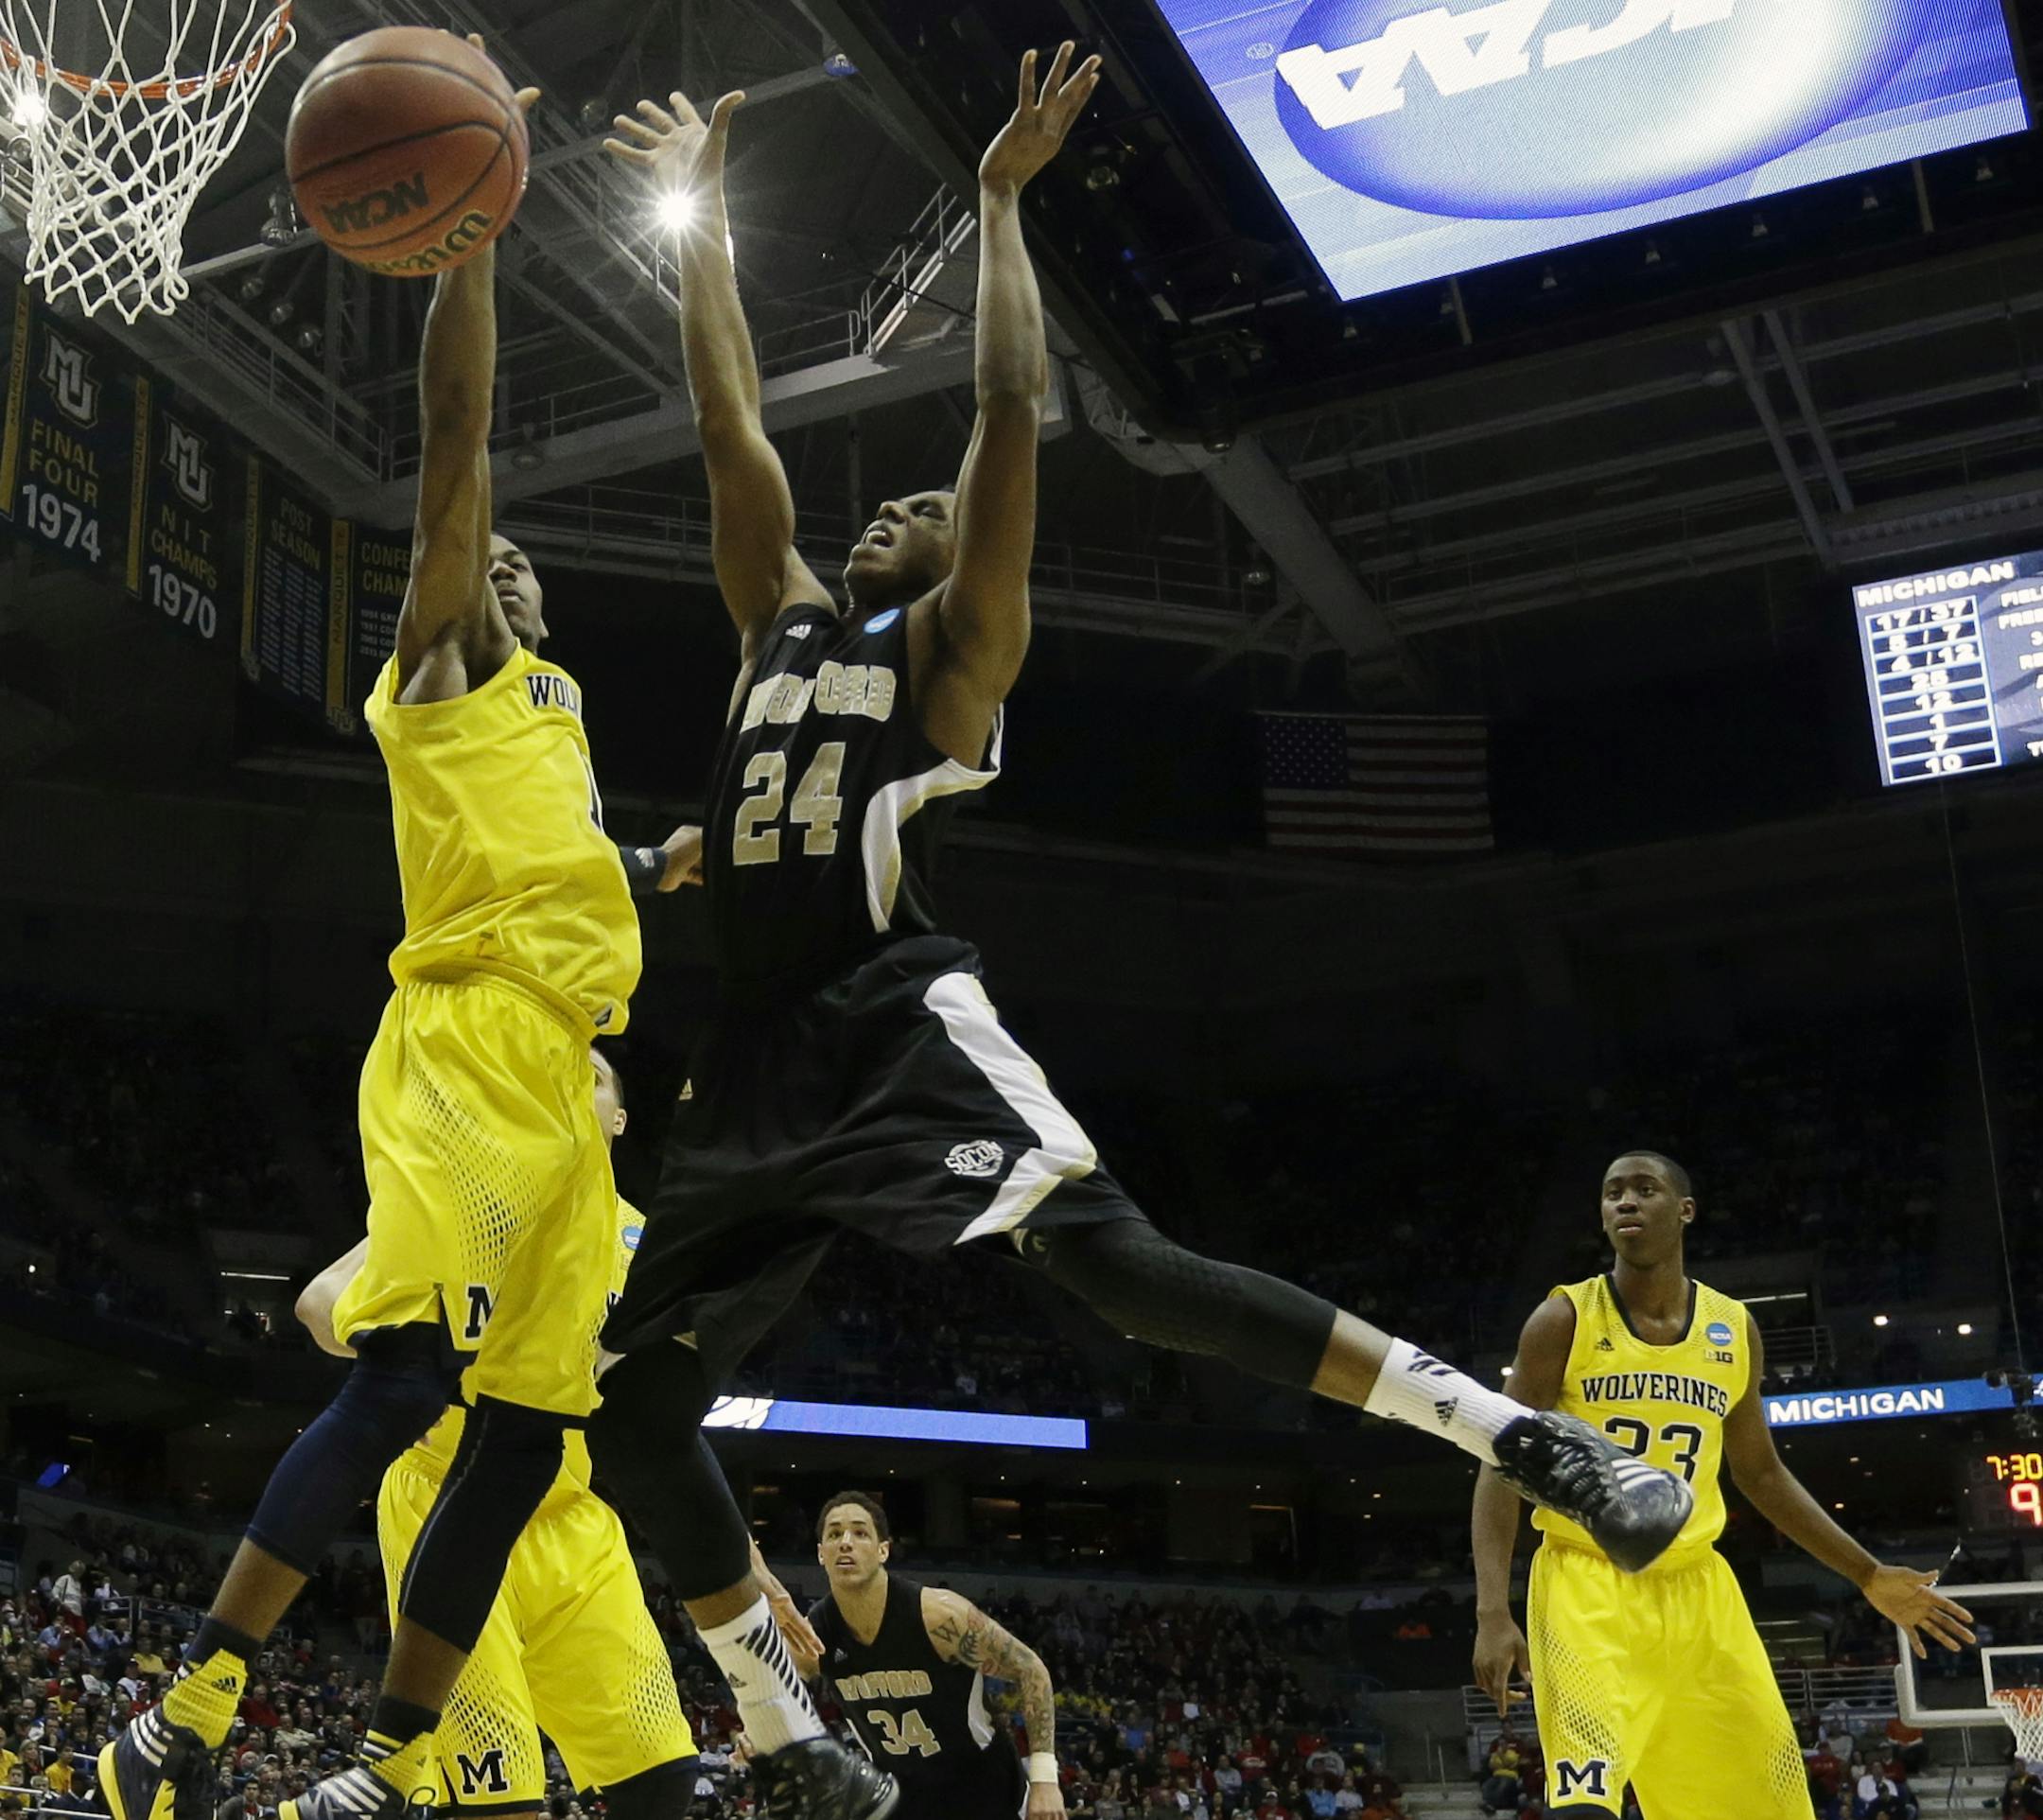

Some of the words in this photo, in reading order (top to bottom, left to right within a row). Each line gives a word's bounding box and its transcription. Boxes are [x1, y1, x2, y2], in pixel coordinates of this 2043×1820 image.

[1276, 0, 1736, 131] CAA
[32, 418, 98, 478] FINAL
[29, 456, 98, 508] FOUR
[23, 483, 101, 563] 1974
[281, 497, 312, 535] POST
[151, 528, 218, 591] CHAMPS
[271, 519, 321, 570] SEASON
[148, 565, 217, 639] 1970
[1857, 561, 2015, 608] MICHIGAN
[1915, 691, 1952, 711] 12
[1929, 713, 1946, 732] 1
[1925, 753, 1963, 775] 10
[1930, 733, 1948, 752] 7
[733, 742, 847, 866] 24
[1580, 1373, 1728, 1417] WOLVERINES
[1769, 1388, 1945, 1423] MICHIGAN
[1986, 1453, 2043, 1481] 7:30
[2011, 1482, 2042, 1526] 9
[866, 1707, 942, 1758] 34
[456, 1749, 509, 1795] M
[1556, 1759, 1607, 1797] M
